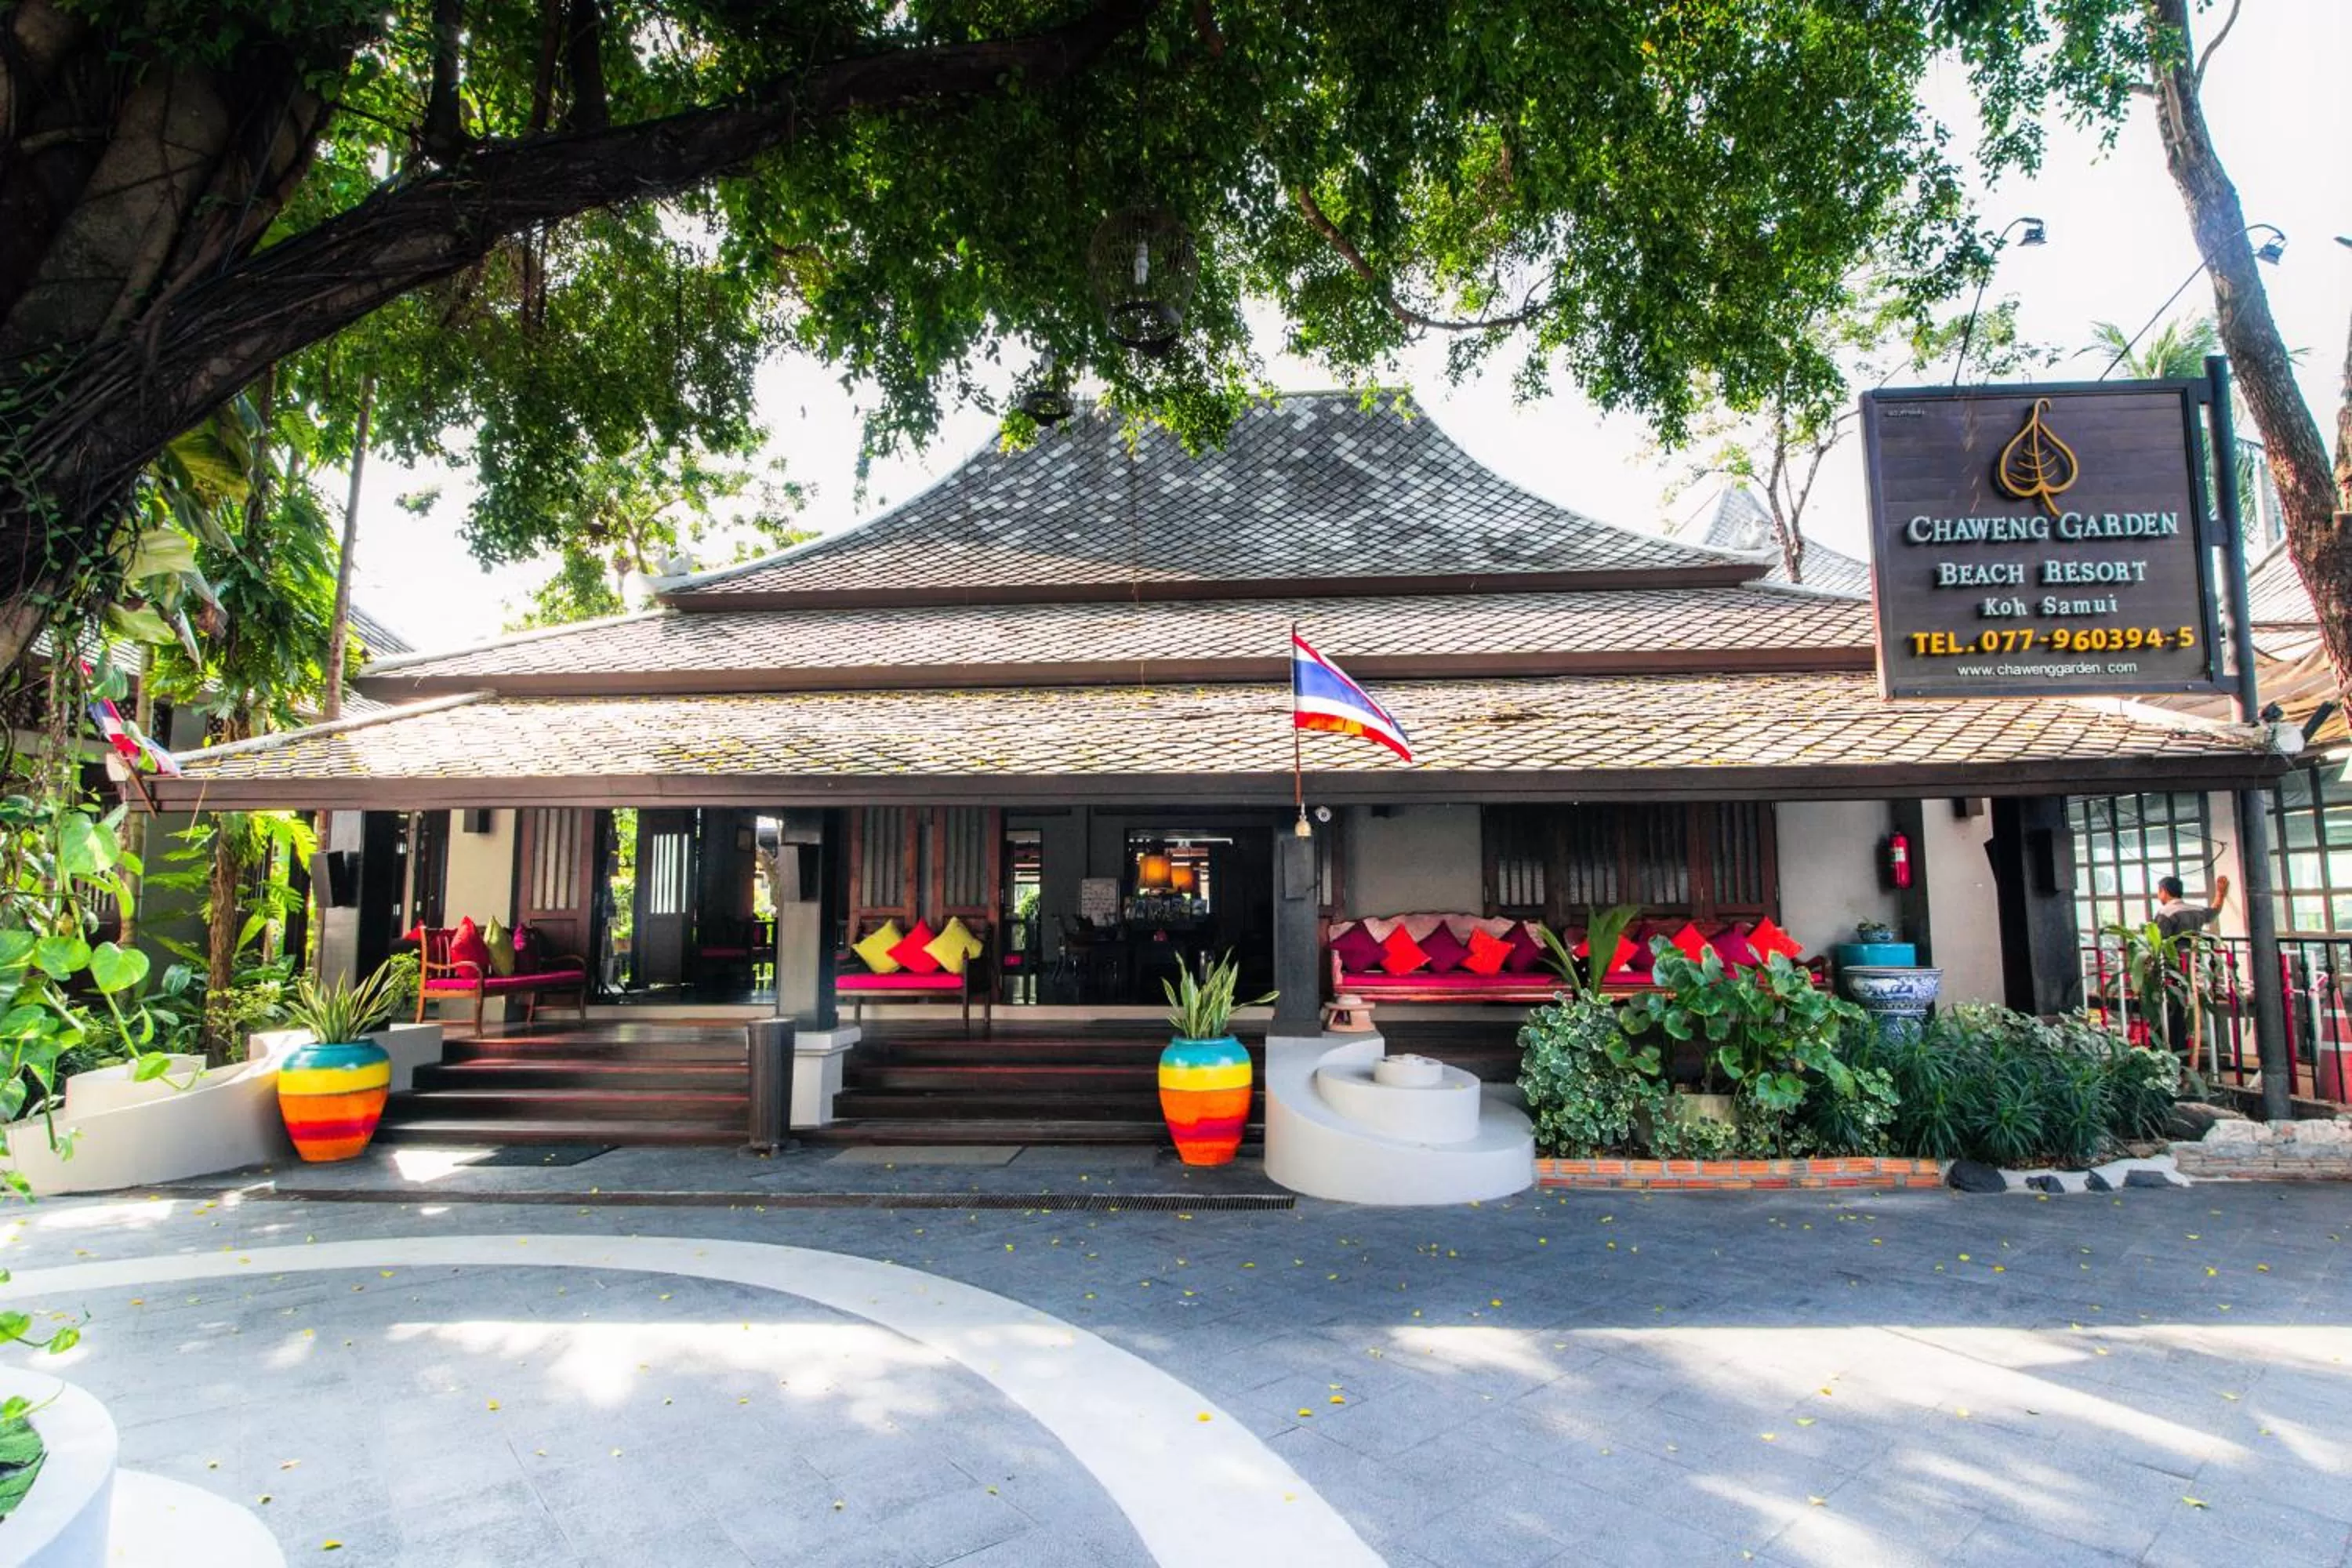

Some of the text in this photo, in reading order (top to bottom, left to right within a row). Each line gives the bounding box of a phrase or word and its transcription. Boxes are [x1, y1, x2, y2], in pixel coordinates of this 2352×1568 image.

[1907, 512, 2180, 543] CHAWENG GARDEN
[1938, 560, 2147, 586] BEACH RESORT
[1984, 593, 2118, 616] Koh Samui
